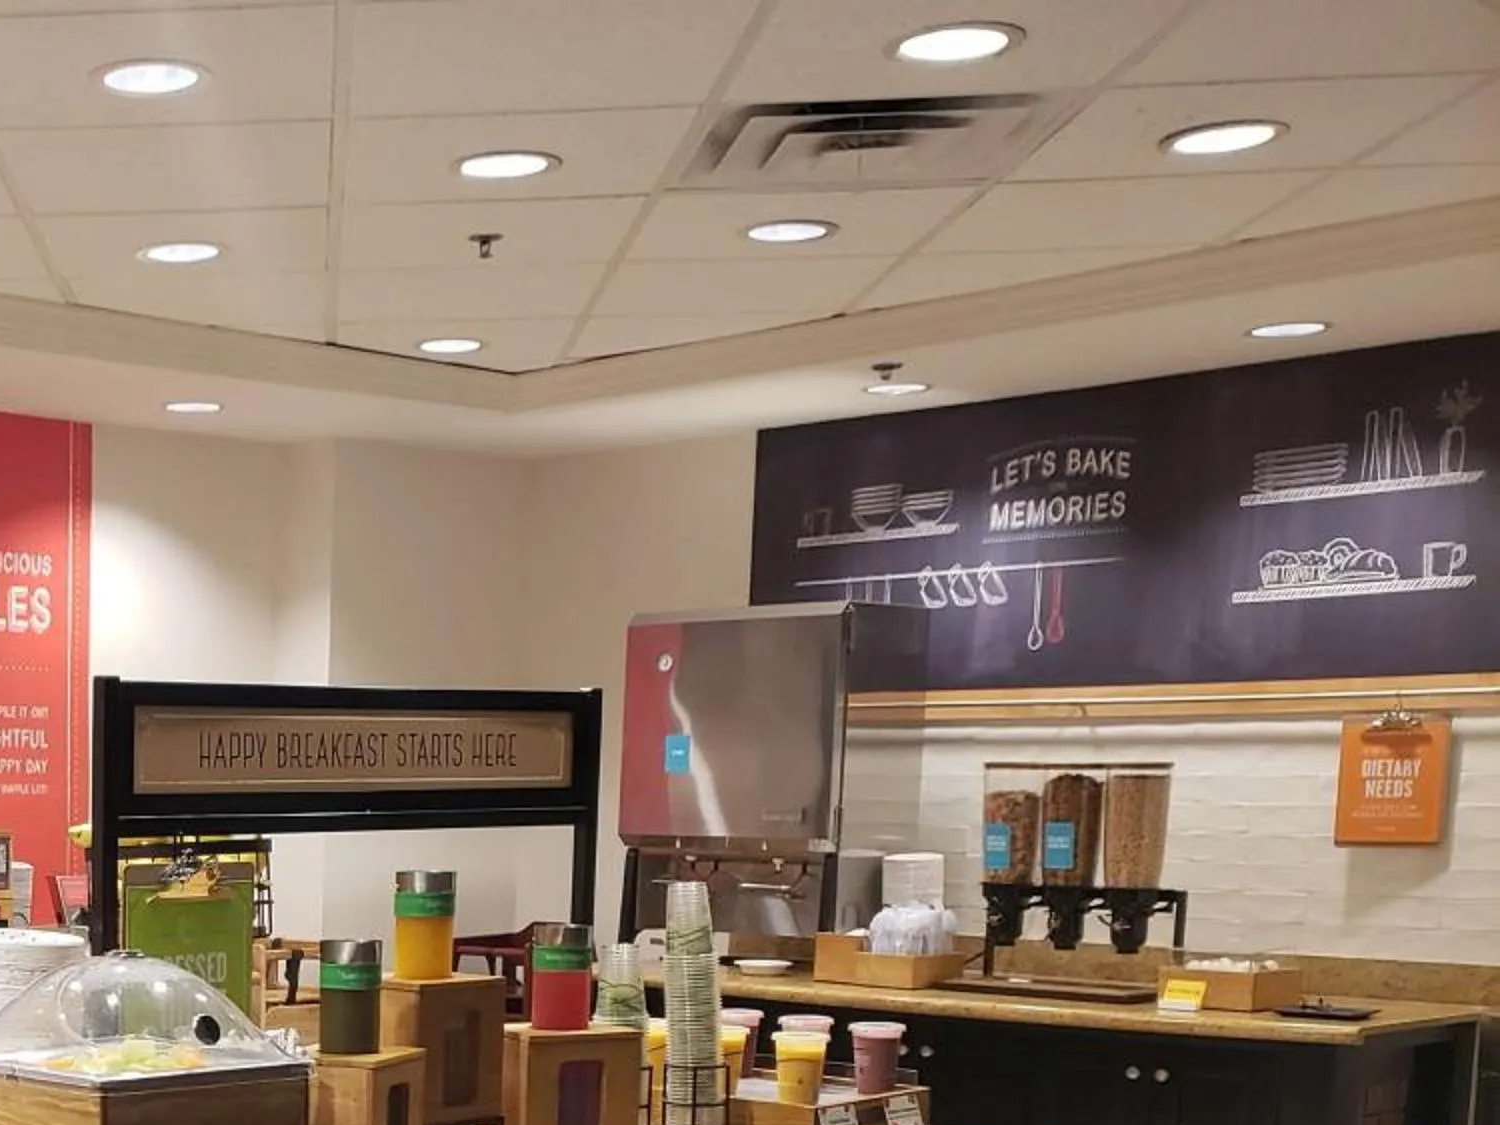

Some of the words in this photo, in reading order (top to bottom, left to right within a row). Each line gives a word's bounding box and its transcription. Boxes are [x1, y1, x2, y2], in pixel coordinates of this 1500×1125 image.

[989, 449, 1057, 495] LET'S
[1065, 447, 1132, 480] BAKE
[988, 490, 1128, 532] MEMORIES
[19, 705, 28, 719] IT
[199, 733, 267, 768] HAPPY
[277, 732, 389, 768] BREAKFAST
[397, 733, 463, 767] STARTS
[472, 733, 517, 767] HERE
[25, 757, 49, 775] DAY
[1361, 758, 1422, 778] DIETARY
[1365, 779, 1413, 799] NEEDS
